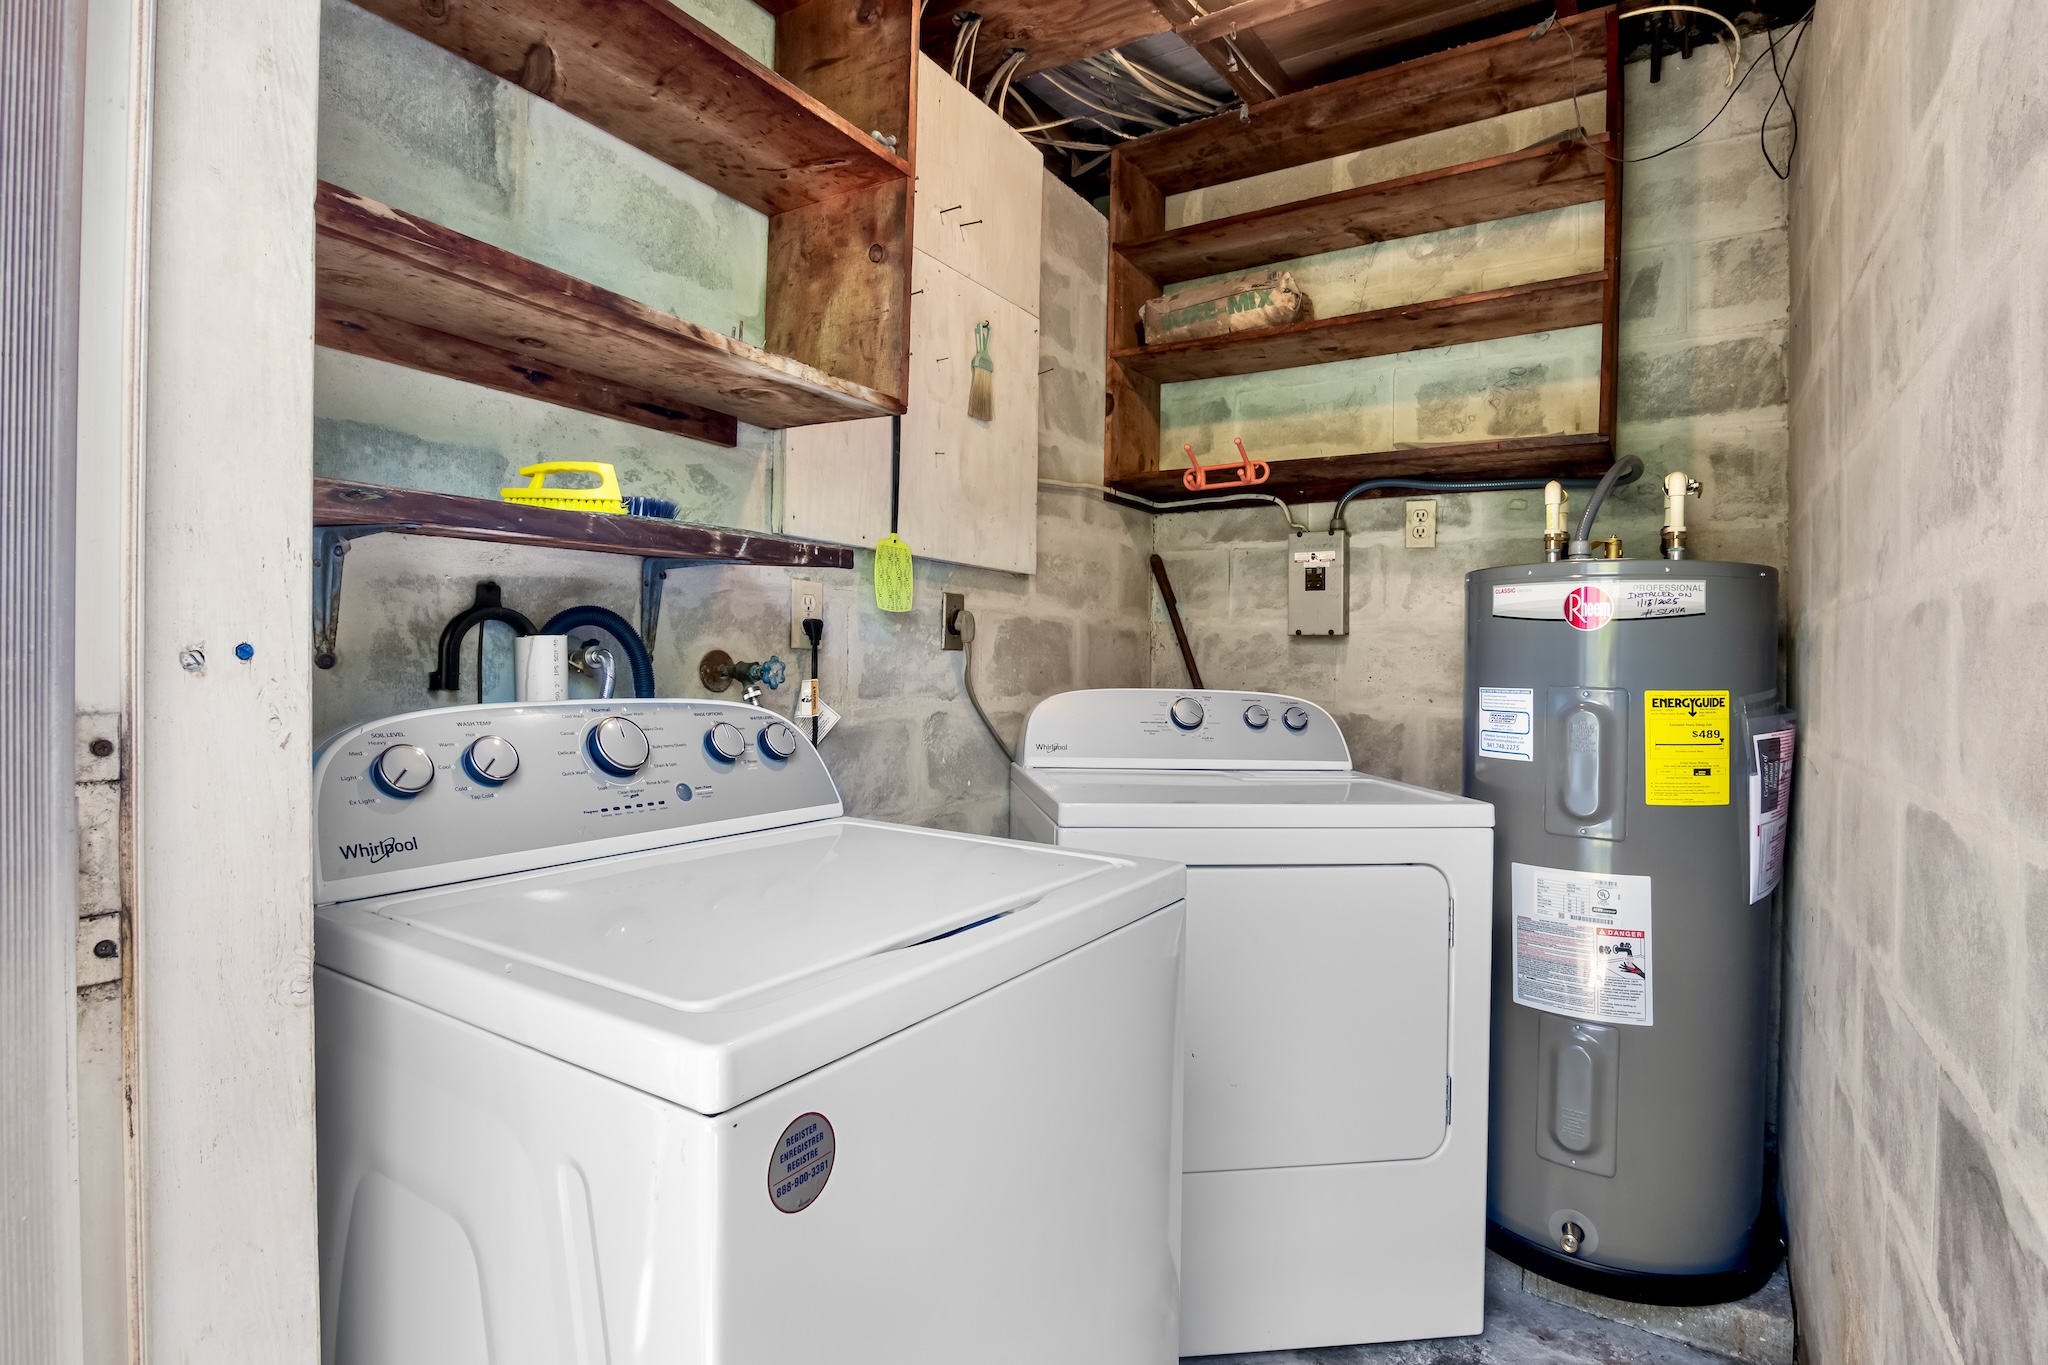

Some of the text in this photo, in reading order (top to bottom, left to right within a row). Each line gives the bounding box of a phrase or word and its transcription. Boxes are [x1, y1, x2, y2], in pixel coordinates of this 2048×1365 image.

[1570, 587, 1610, 623] Rheem
[1652, 698, 1725, 708] ENERGYGUIDE
[1487, 742, 1519, 751] 941.748.2275
[1692, 730, 1720, 738] $489
[1036, 743, 1068, 753] Whirlpool
[339, 837, 418, 863] Whirlpool
[786, 1123, 817, 1147] REGISTER
[780, 1132, 824, 1164] ENREGISTRER
[787, 1147, 818, 1173] REGISTRE
[777, 1159, 828, 1198] 888-900-3381
